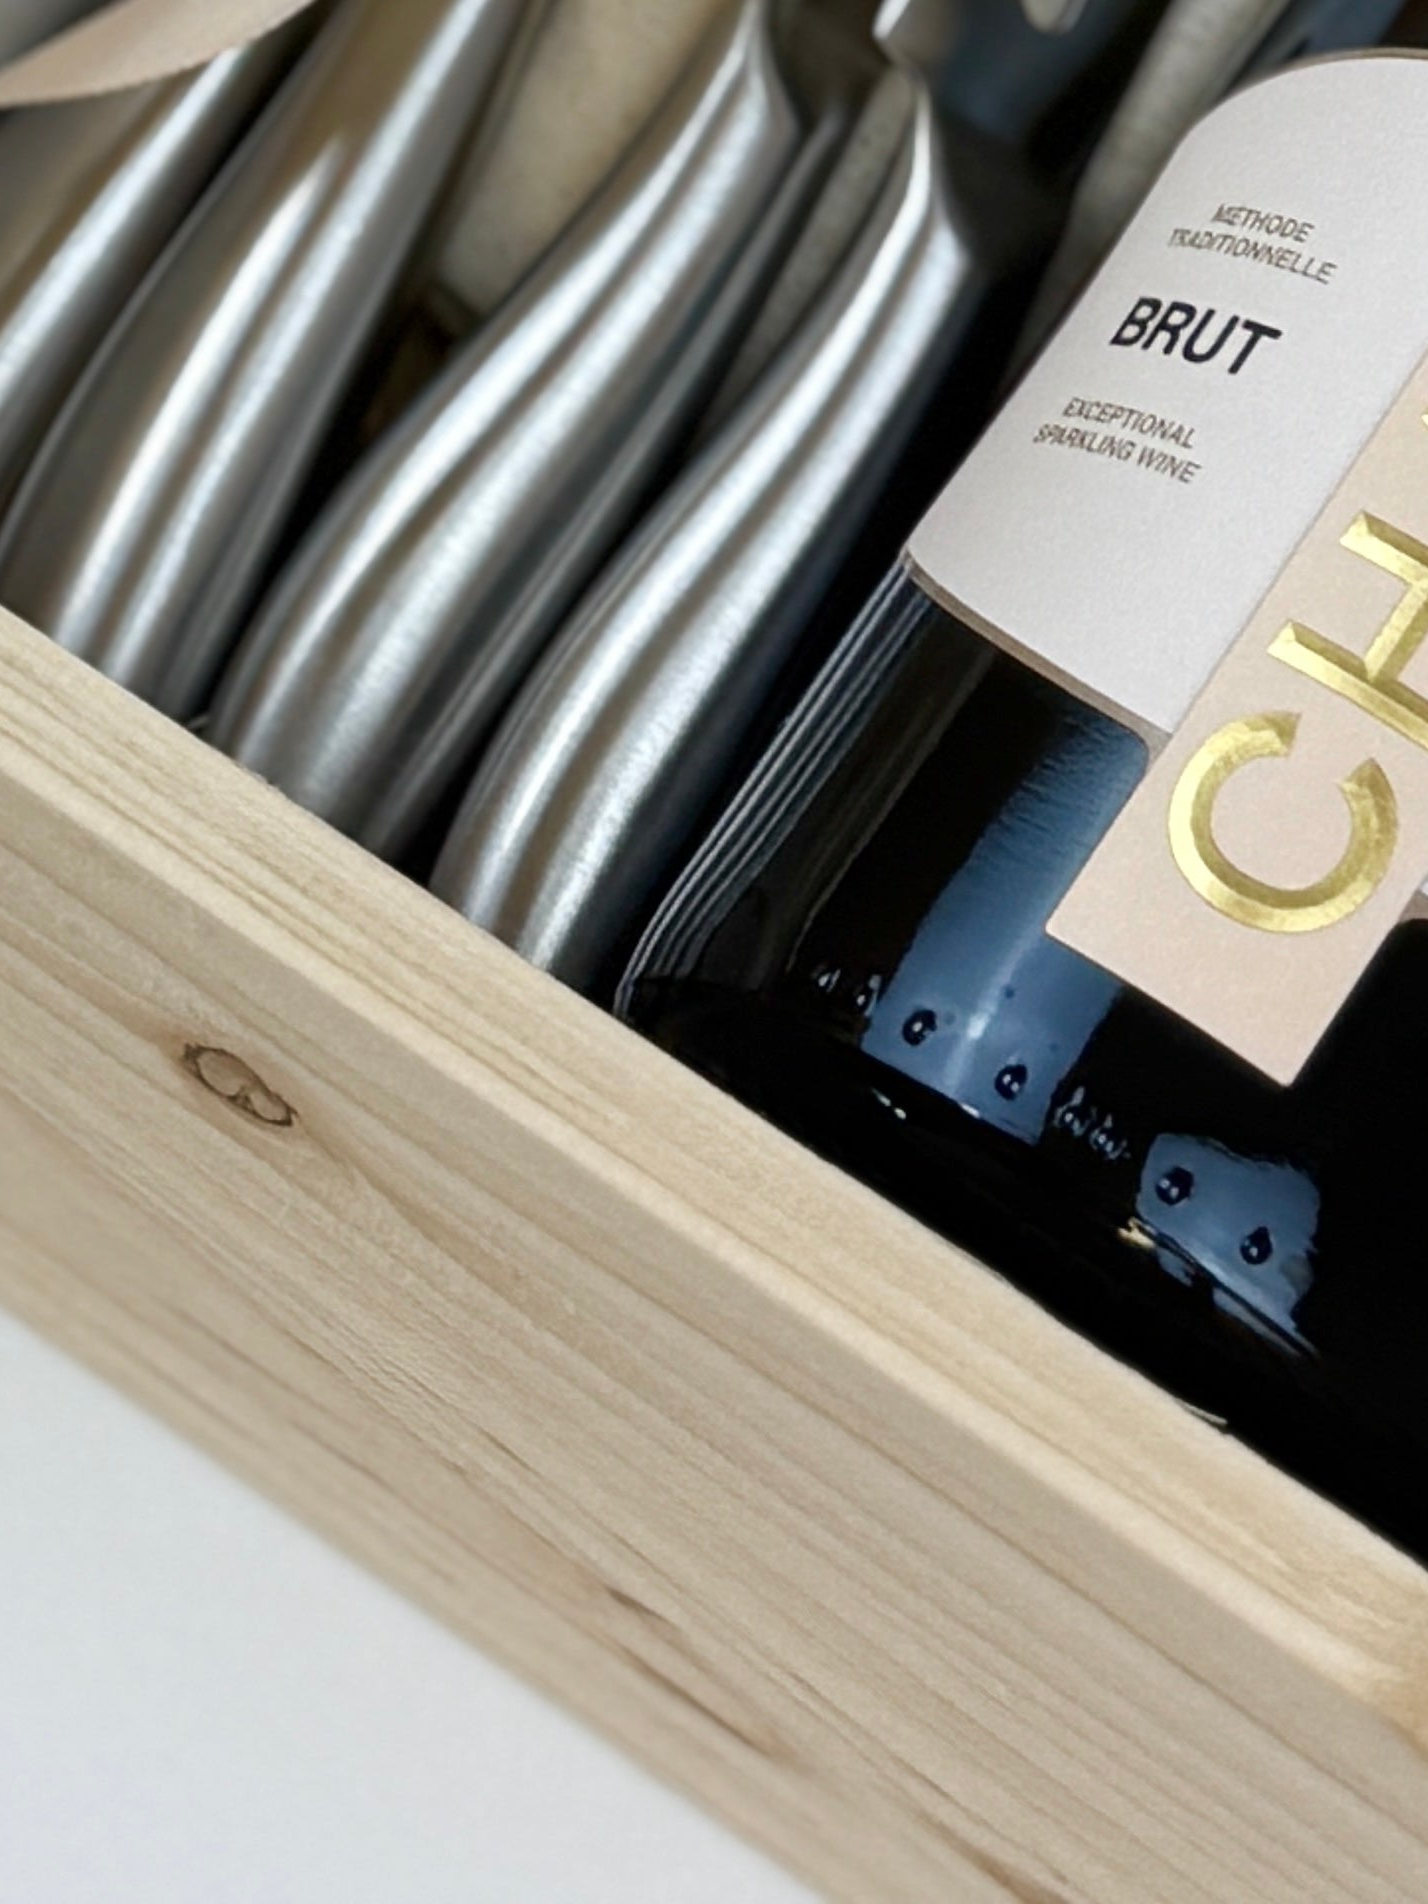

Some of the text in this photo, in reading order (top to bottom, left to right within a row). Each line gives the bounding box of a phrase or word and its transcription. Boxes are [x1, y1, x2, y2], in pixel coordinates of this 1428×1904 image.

[1168, 228, 1338, 285] TRADITIONNELLE
[1109, 297, 1283, 375] BRUT
[1062, 396, 1196, 450] EXCEPTIONAL
[1032, 423, 1202, 484] SPARKLING WINE
